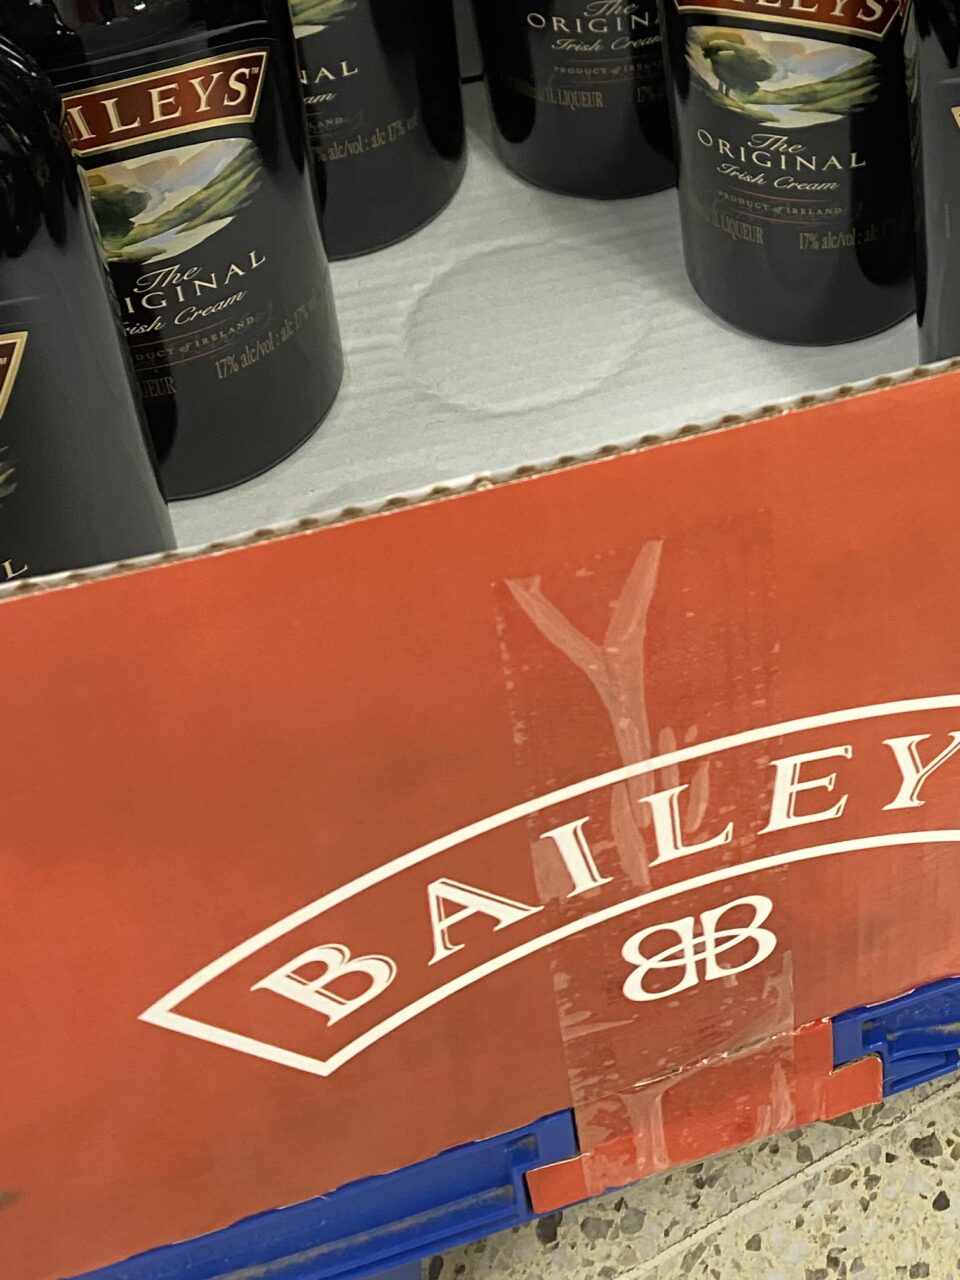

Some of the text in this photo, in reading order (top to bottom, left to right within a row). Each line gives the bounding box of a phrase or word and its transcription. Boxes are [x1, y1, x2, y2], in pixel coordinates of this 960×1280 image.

[526, 11, 651, 34] ORIGIN
[551, 38, 604, 52] Irish
[697, 128, 867, 172] ORIGINAL
[747, 132, 807, 154] The
[716, 162, 842, 192] Irish Cream
[123, 249, 267, 314] IGINAL
[133, 263, 203, 294] The
[173, 289, 249, 326] Cream
[135, 347, 177, 362] DUCT
